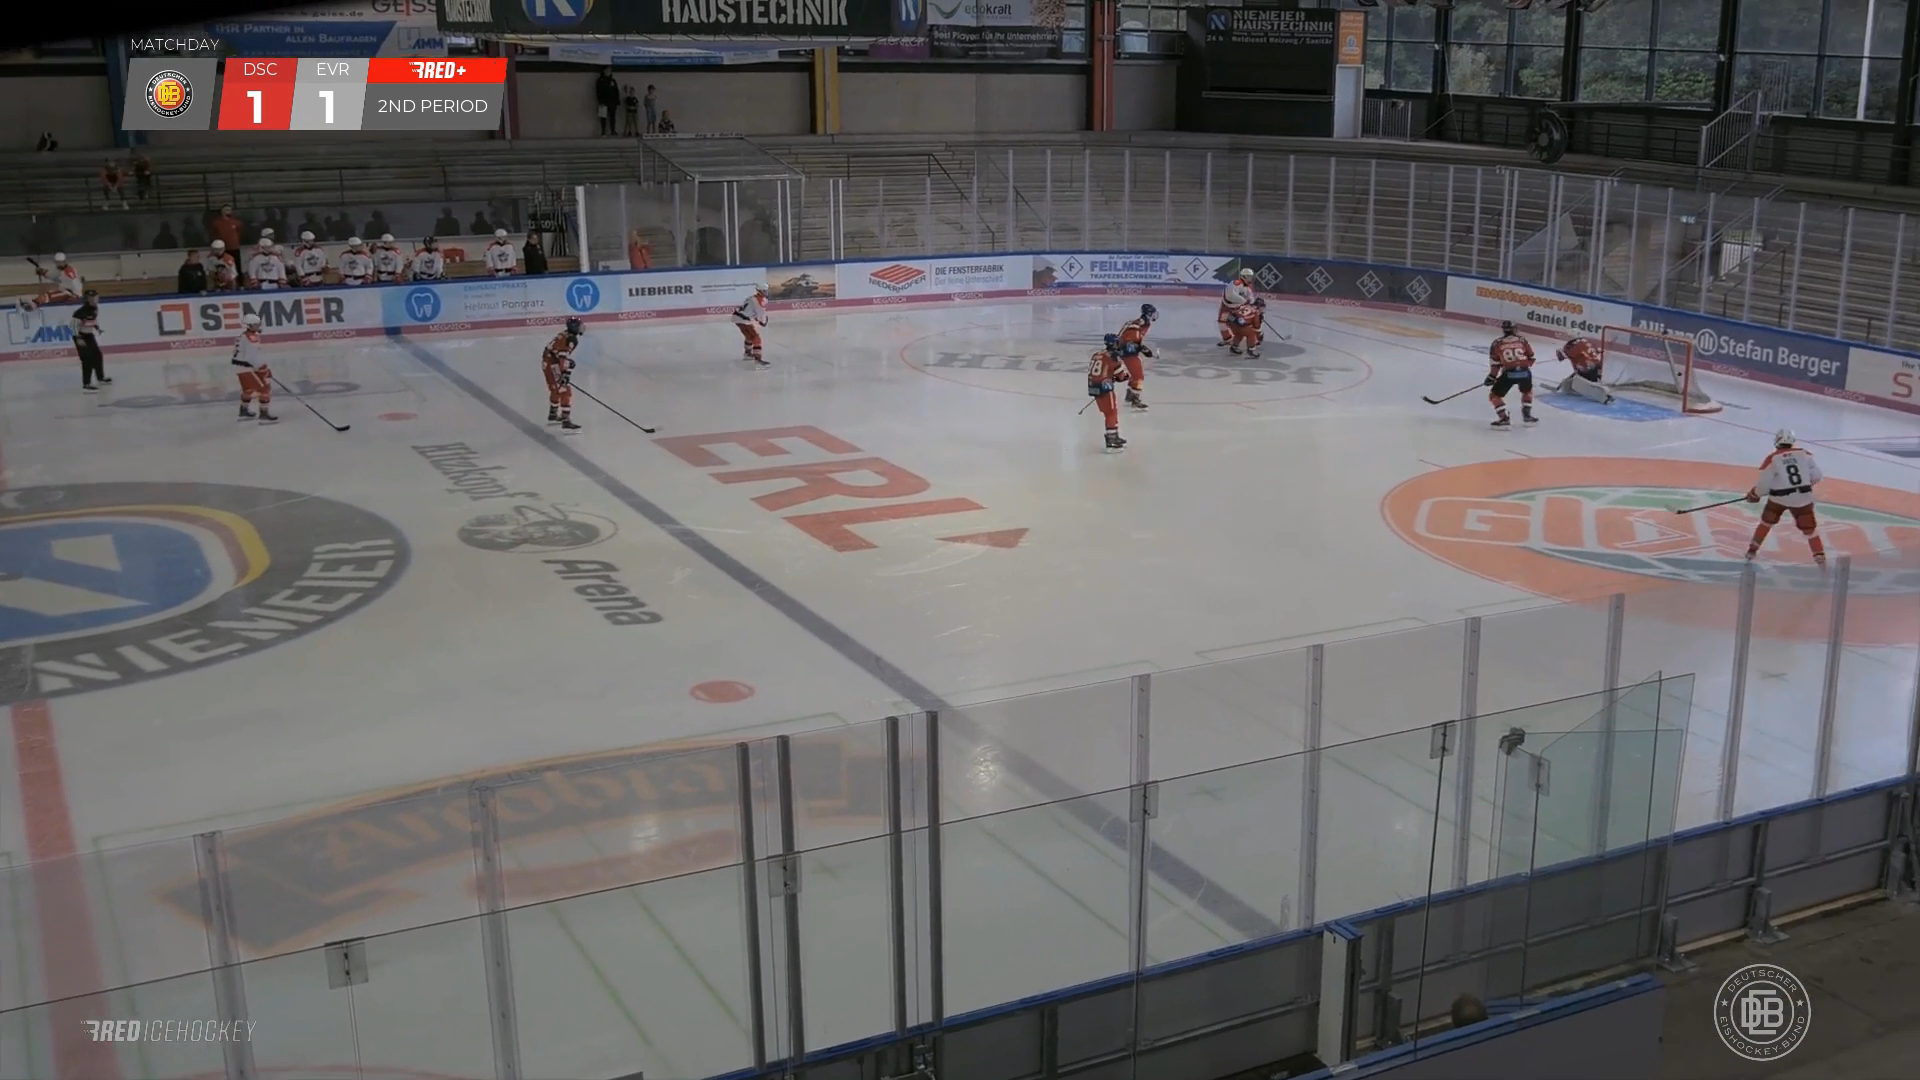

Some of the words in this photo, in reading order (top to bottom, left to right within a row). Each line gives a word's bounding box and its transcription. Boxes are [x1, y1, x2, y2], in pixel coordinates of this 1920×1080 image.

[662, 0, 849, 26] HAUSTECHNIK
[1233, 10, 1306, 21] NIEMEIER
[1233, 20, 1334, 32] HAUSTECHNIK
[935, 266, 947, 276] DIE
[948, 264, 1005, 275] FENSTERFABRIK
[1090, 260, 1170, 273] FEILMEIER
[628, 284, 694, 297] LIEBHERR
[868, 274, 927, 293] NIEDERHOFER
[464, 301, 500, 312] Helmut
[502, 300, 546, 313] Pongratz
[1475, 285, 1584, 315] montageservice
[200, 296, 345, 332] SEMMER
[1527, 310, 1567, 328] daniel
[1570, 319, 1602, 334] eder
[1718, 335, 1774, 363] Stefan
[1776, 346, 1841, 377] Berger
[1891, 371, 1920, 398] S
[1786, 464, 1802, 486] 8
[650, 425, 988, 553] ERL
[541, 558, 664, 626] Arena
[33, 537, 396, 693] NIEMEIER
